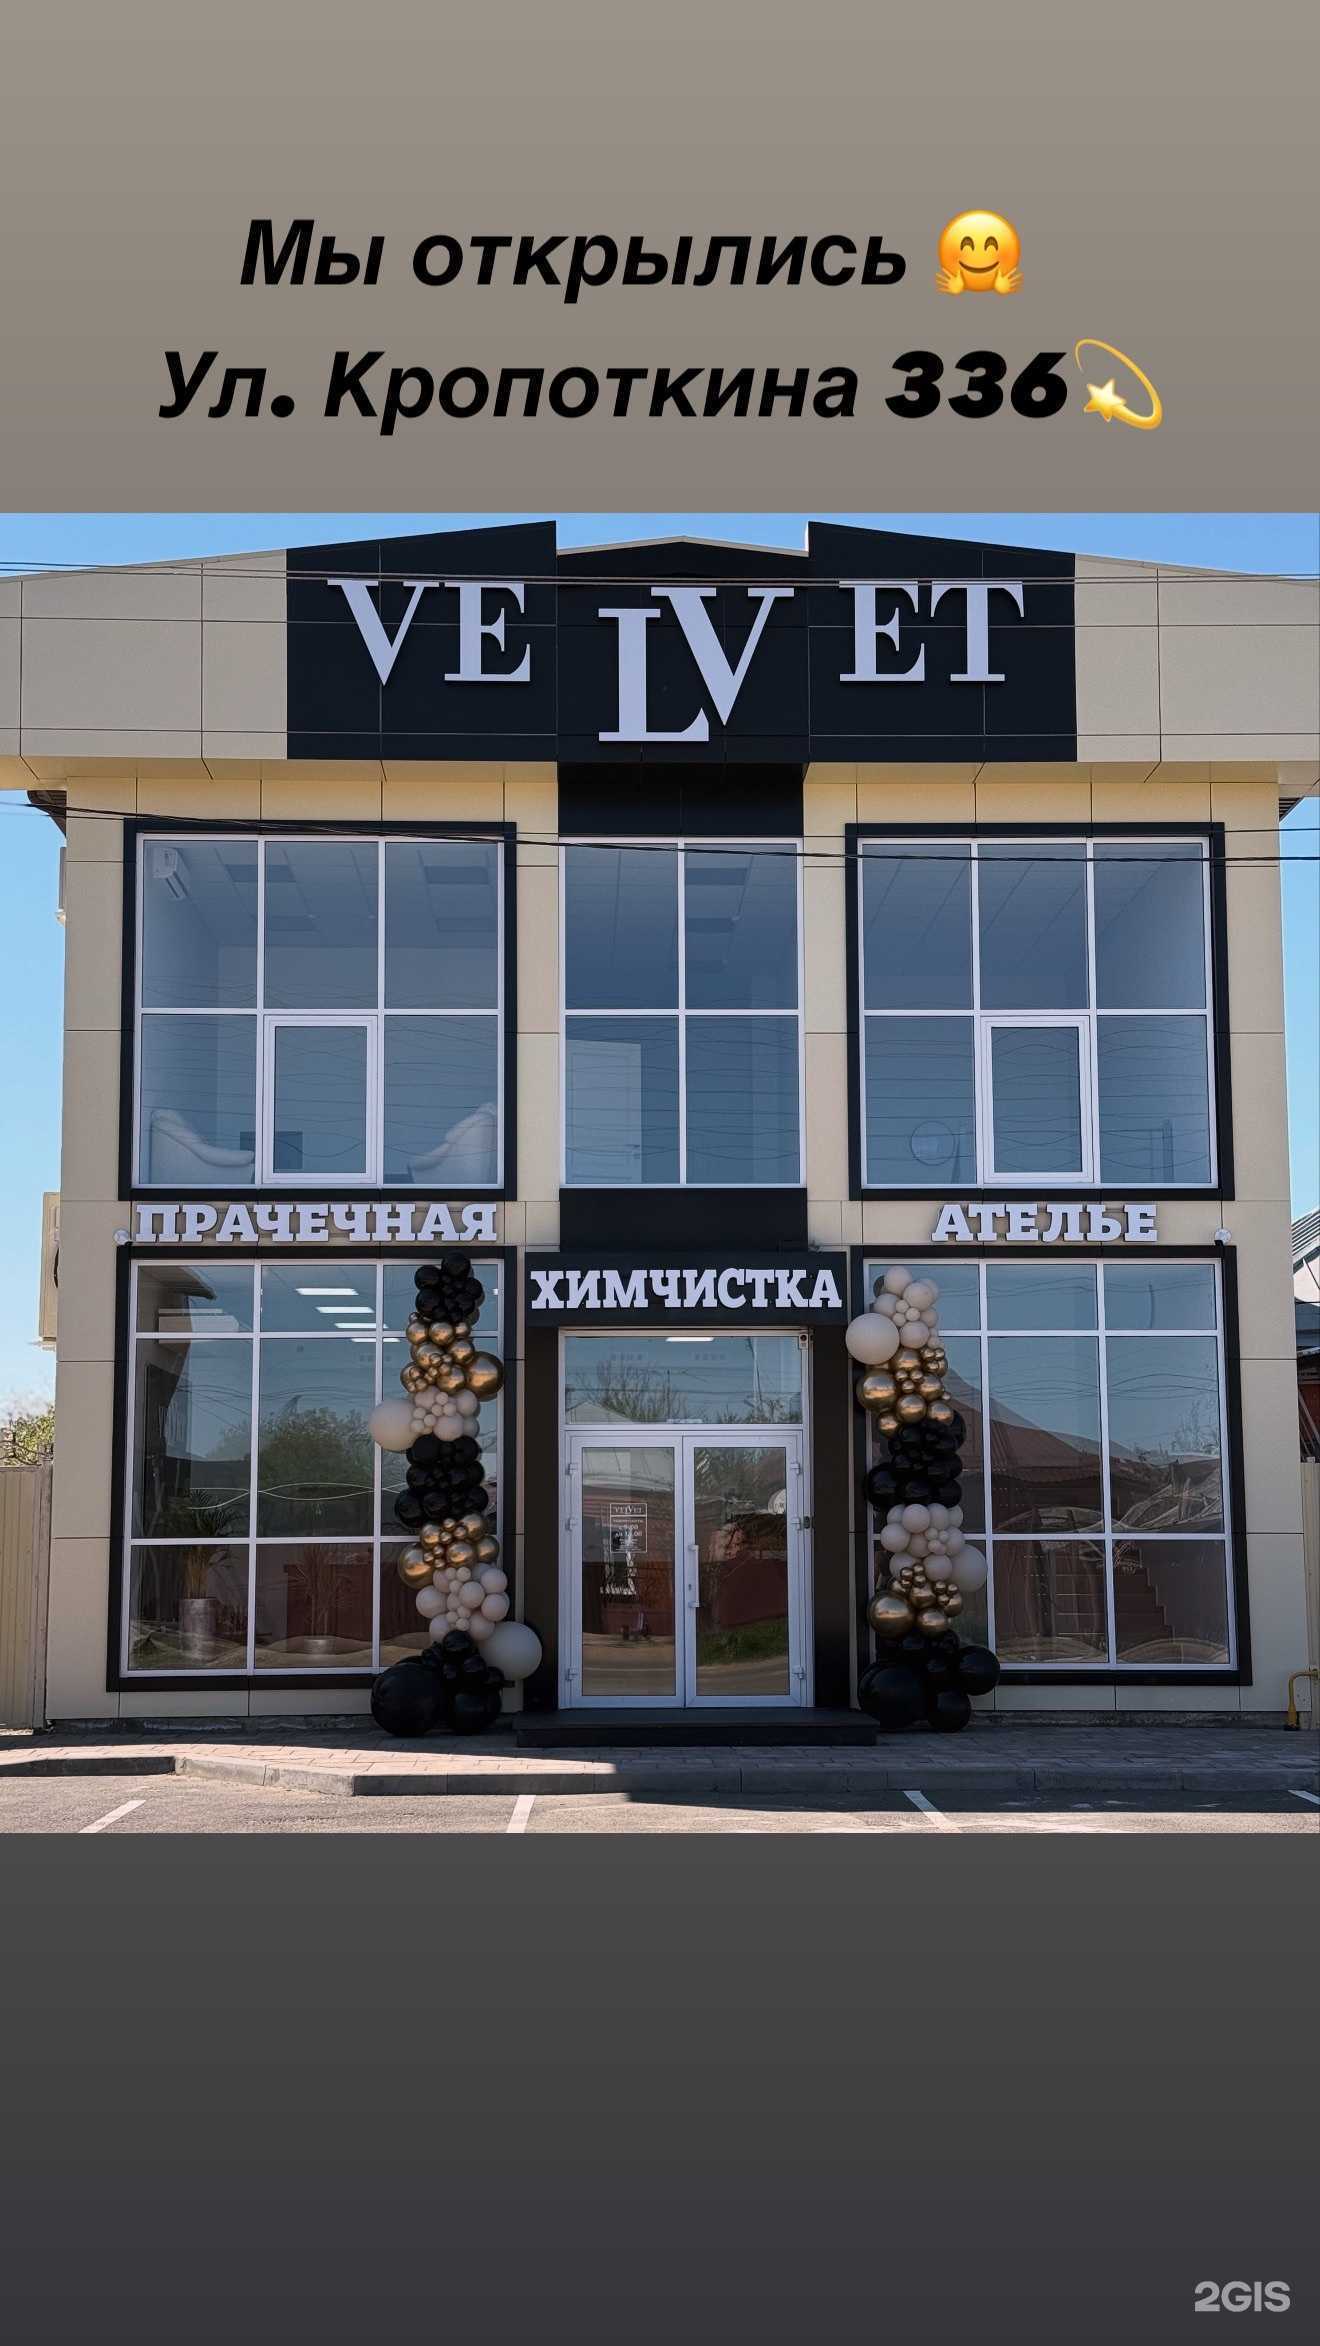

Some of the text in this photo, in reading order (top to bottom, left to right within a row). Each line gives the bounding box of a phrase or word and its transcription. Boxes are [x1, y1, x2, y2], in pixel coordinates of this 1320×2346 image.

[135, 1203, 497, 1242] ПРАЧЕЧНАЯ
[931, 1203, 1158, 1242] АТЕЛЬЕ
[530, 1267, 843, 1310] ХИМЧИСТКА
